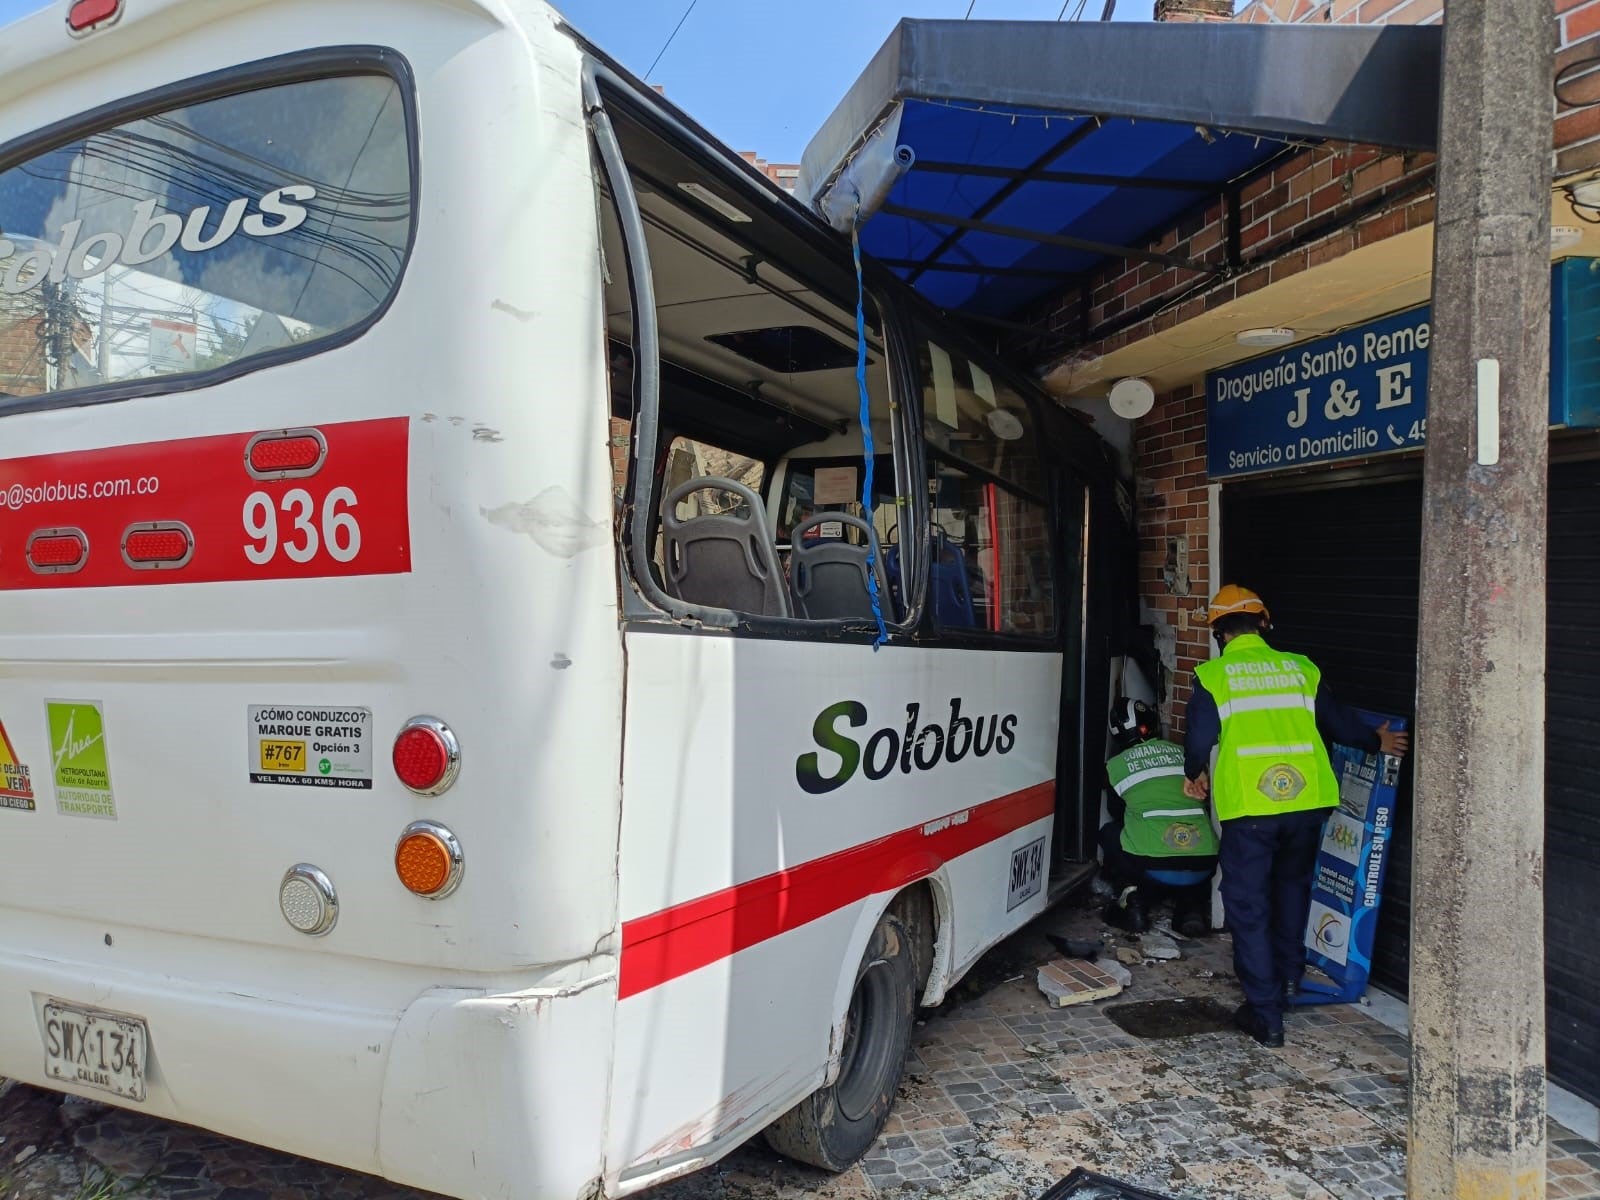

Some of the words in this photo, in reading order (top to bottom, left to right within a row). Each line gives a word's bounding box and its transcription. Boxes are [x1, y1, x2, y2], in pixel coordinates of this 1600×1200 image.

[1216, 356, 1296, 402] Droguería
[1301, 342, 1357, 380] Santo
[1286, 387, 1311, 429] J
[1324, 378, 1361, 421] &
[1375, 362, 1412, 411] E
[1228, 446, 1282, 470] Servicio
[1285, 444, 1296, 461] a
[1300, 426, 1379, 458] Domicilio
[242, 486, 361, 565] 936
[1225, 662, 1280, 676] OFICIAL
[1281, 659, 1301, 672] DE
[1229, 672, 1307, 691] SEGURIDAD
[254, 708, 294, 722] ¿CÓMO
[296, 710, 366, 723] CONDUZCO?
[258, 724, 312, 736] MARQUE
[315, 726, 362, 738] GRATIS
[265, 744, 302, 761] #767
[312, 742, 350, 754] Opción
[353, 744, 360, 753] 3
[795, 697, 1018, 795] Solobus
[3, 763, 30, 777] DEJATE
[60, 767, 106, 778] METROPOLITANA
[1127, 760, 1141, 773] DE
[257, 775, 276, 783] VEL.
[278, 776, 300, 784] MAX.
[301, 777, 313, 785] 60
[338, 779, 364, 788] HORA
[9, 797, 29, 808] CIEGO
[58, 791, 101, 803] AUTORIDAD
[101, 794, 113, 804] DE
[59, 801, 115, 816] TRANSPORTE
[1374, 807, 1389, 834] PESO
[1372, 836, 1385, 851] SU
[1364, 852, 1382, 907] CONTROLE
[77, 1068, 109, 1086] CALDAS
